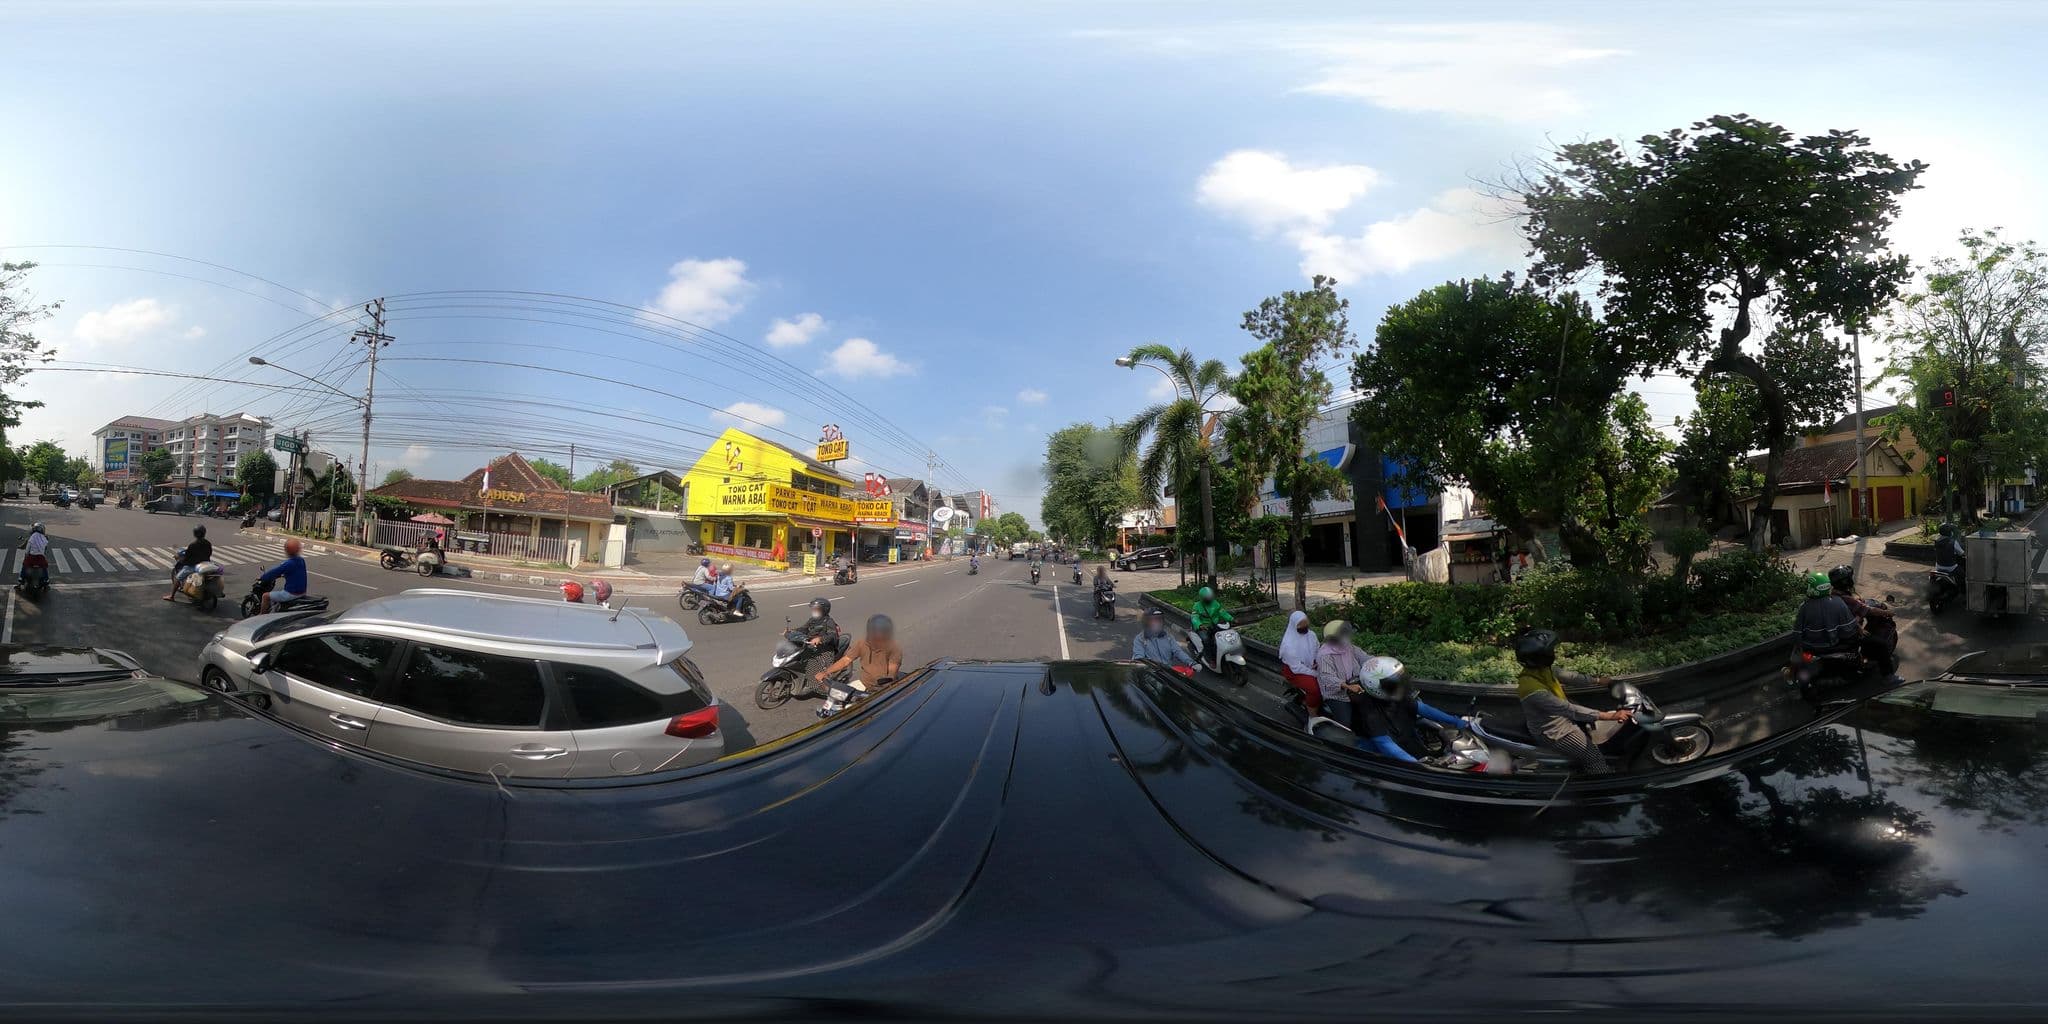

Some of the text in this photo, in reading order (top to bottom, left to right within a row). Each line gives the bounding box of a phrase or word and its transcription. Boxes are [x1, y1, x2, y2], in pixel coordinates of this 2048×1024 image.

[818, 443, 833, 456] TOKO
[833, 441, 844, 453] CAT
[1877, 455, 1885, 472] A
[728, 483, 765, 493] TOKO CAT
[775, 488, 796, 499] PARKIR
[722, 495, 746, 505] WARNA
[772, 498, 787, 509] TOKO
[787, 501, 798, 510] CAT
[820, 500, 838, 509] WARNA
[857, 502, 889, 510] TOKO CAT
